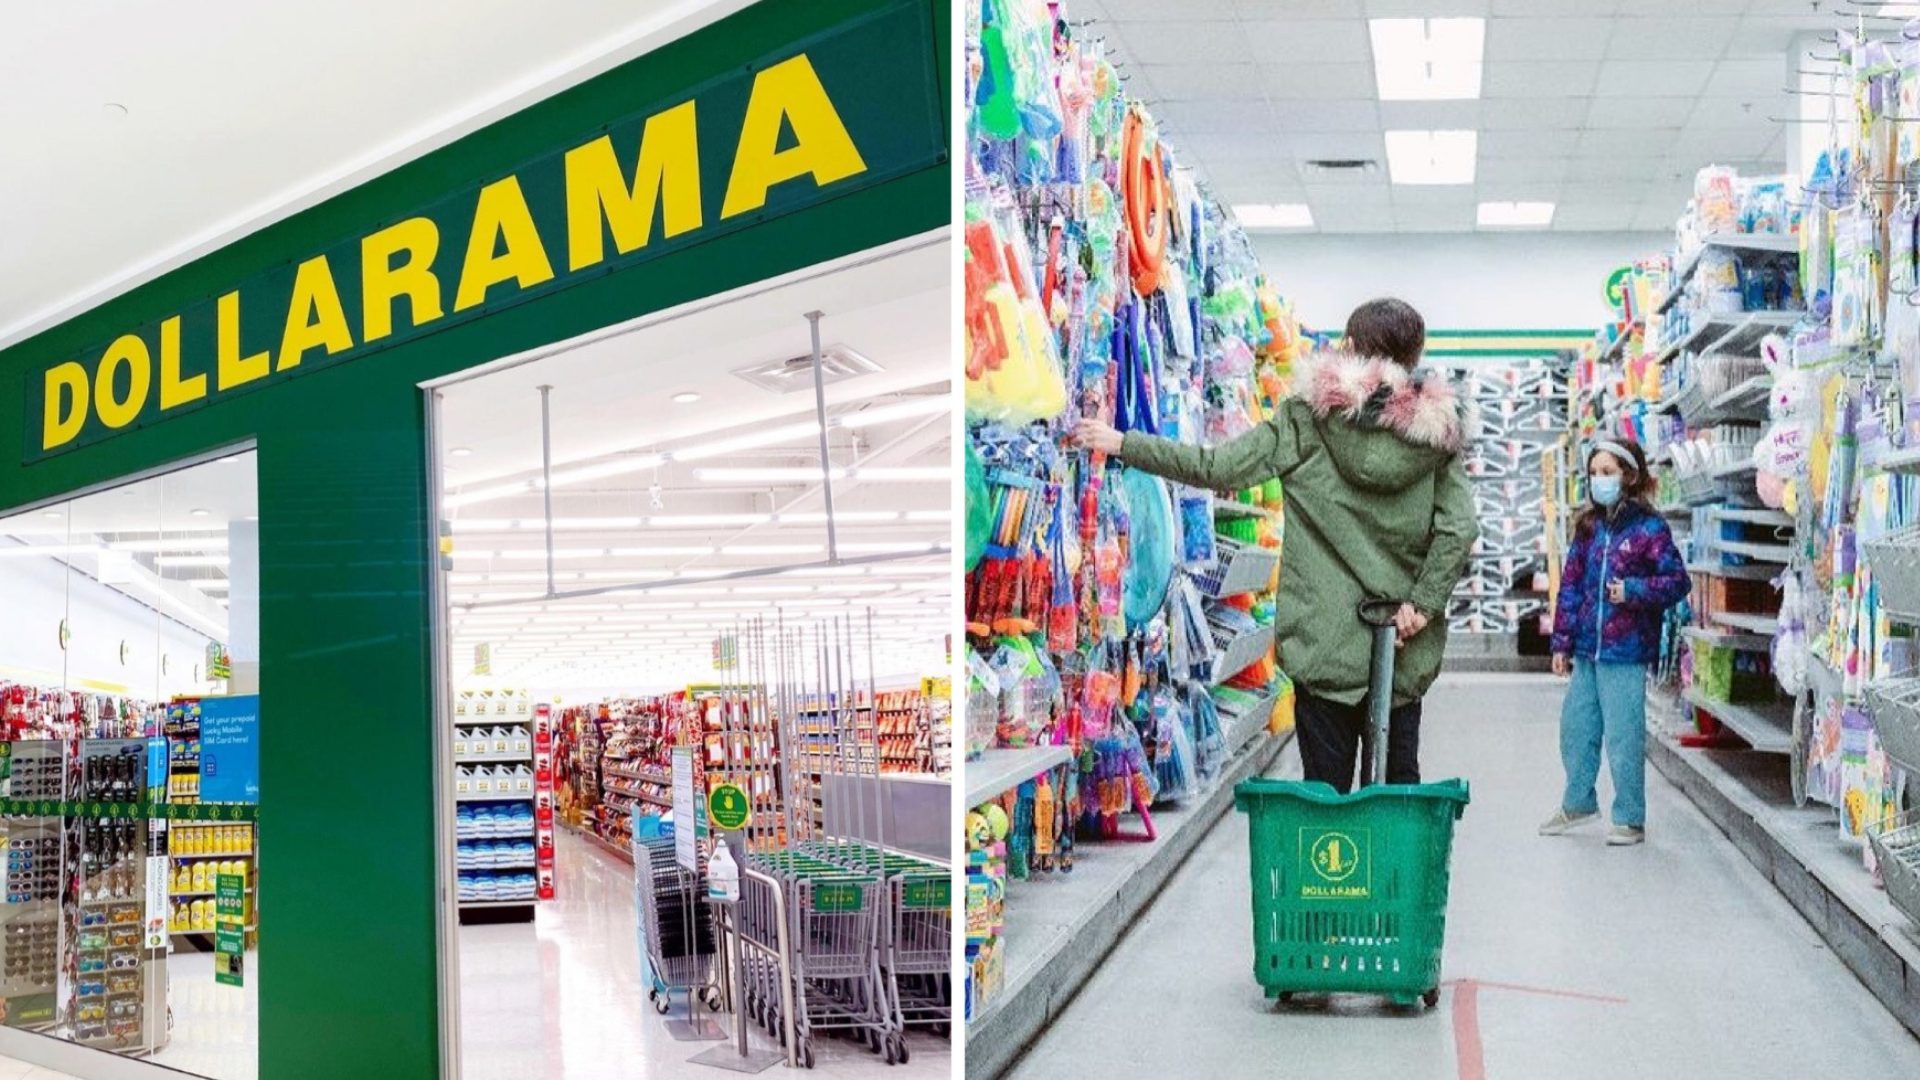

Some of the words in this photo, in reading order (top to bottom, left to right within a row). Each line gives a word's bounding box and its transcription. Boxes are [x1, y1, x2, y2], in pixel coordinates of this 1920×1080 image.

[42, 53, 868, 451] DOLLARAMA
[216, 717, 230, 726] your
[231, 714, 256, 725] prepaid
[1302, 886, 1369, 897] DOLLARAMA
